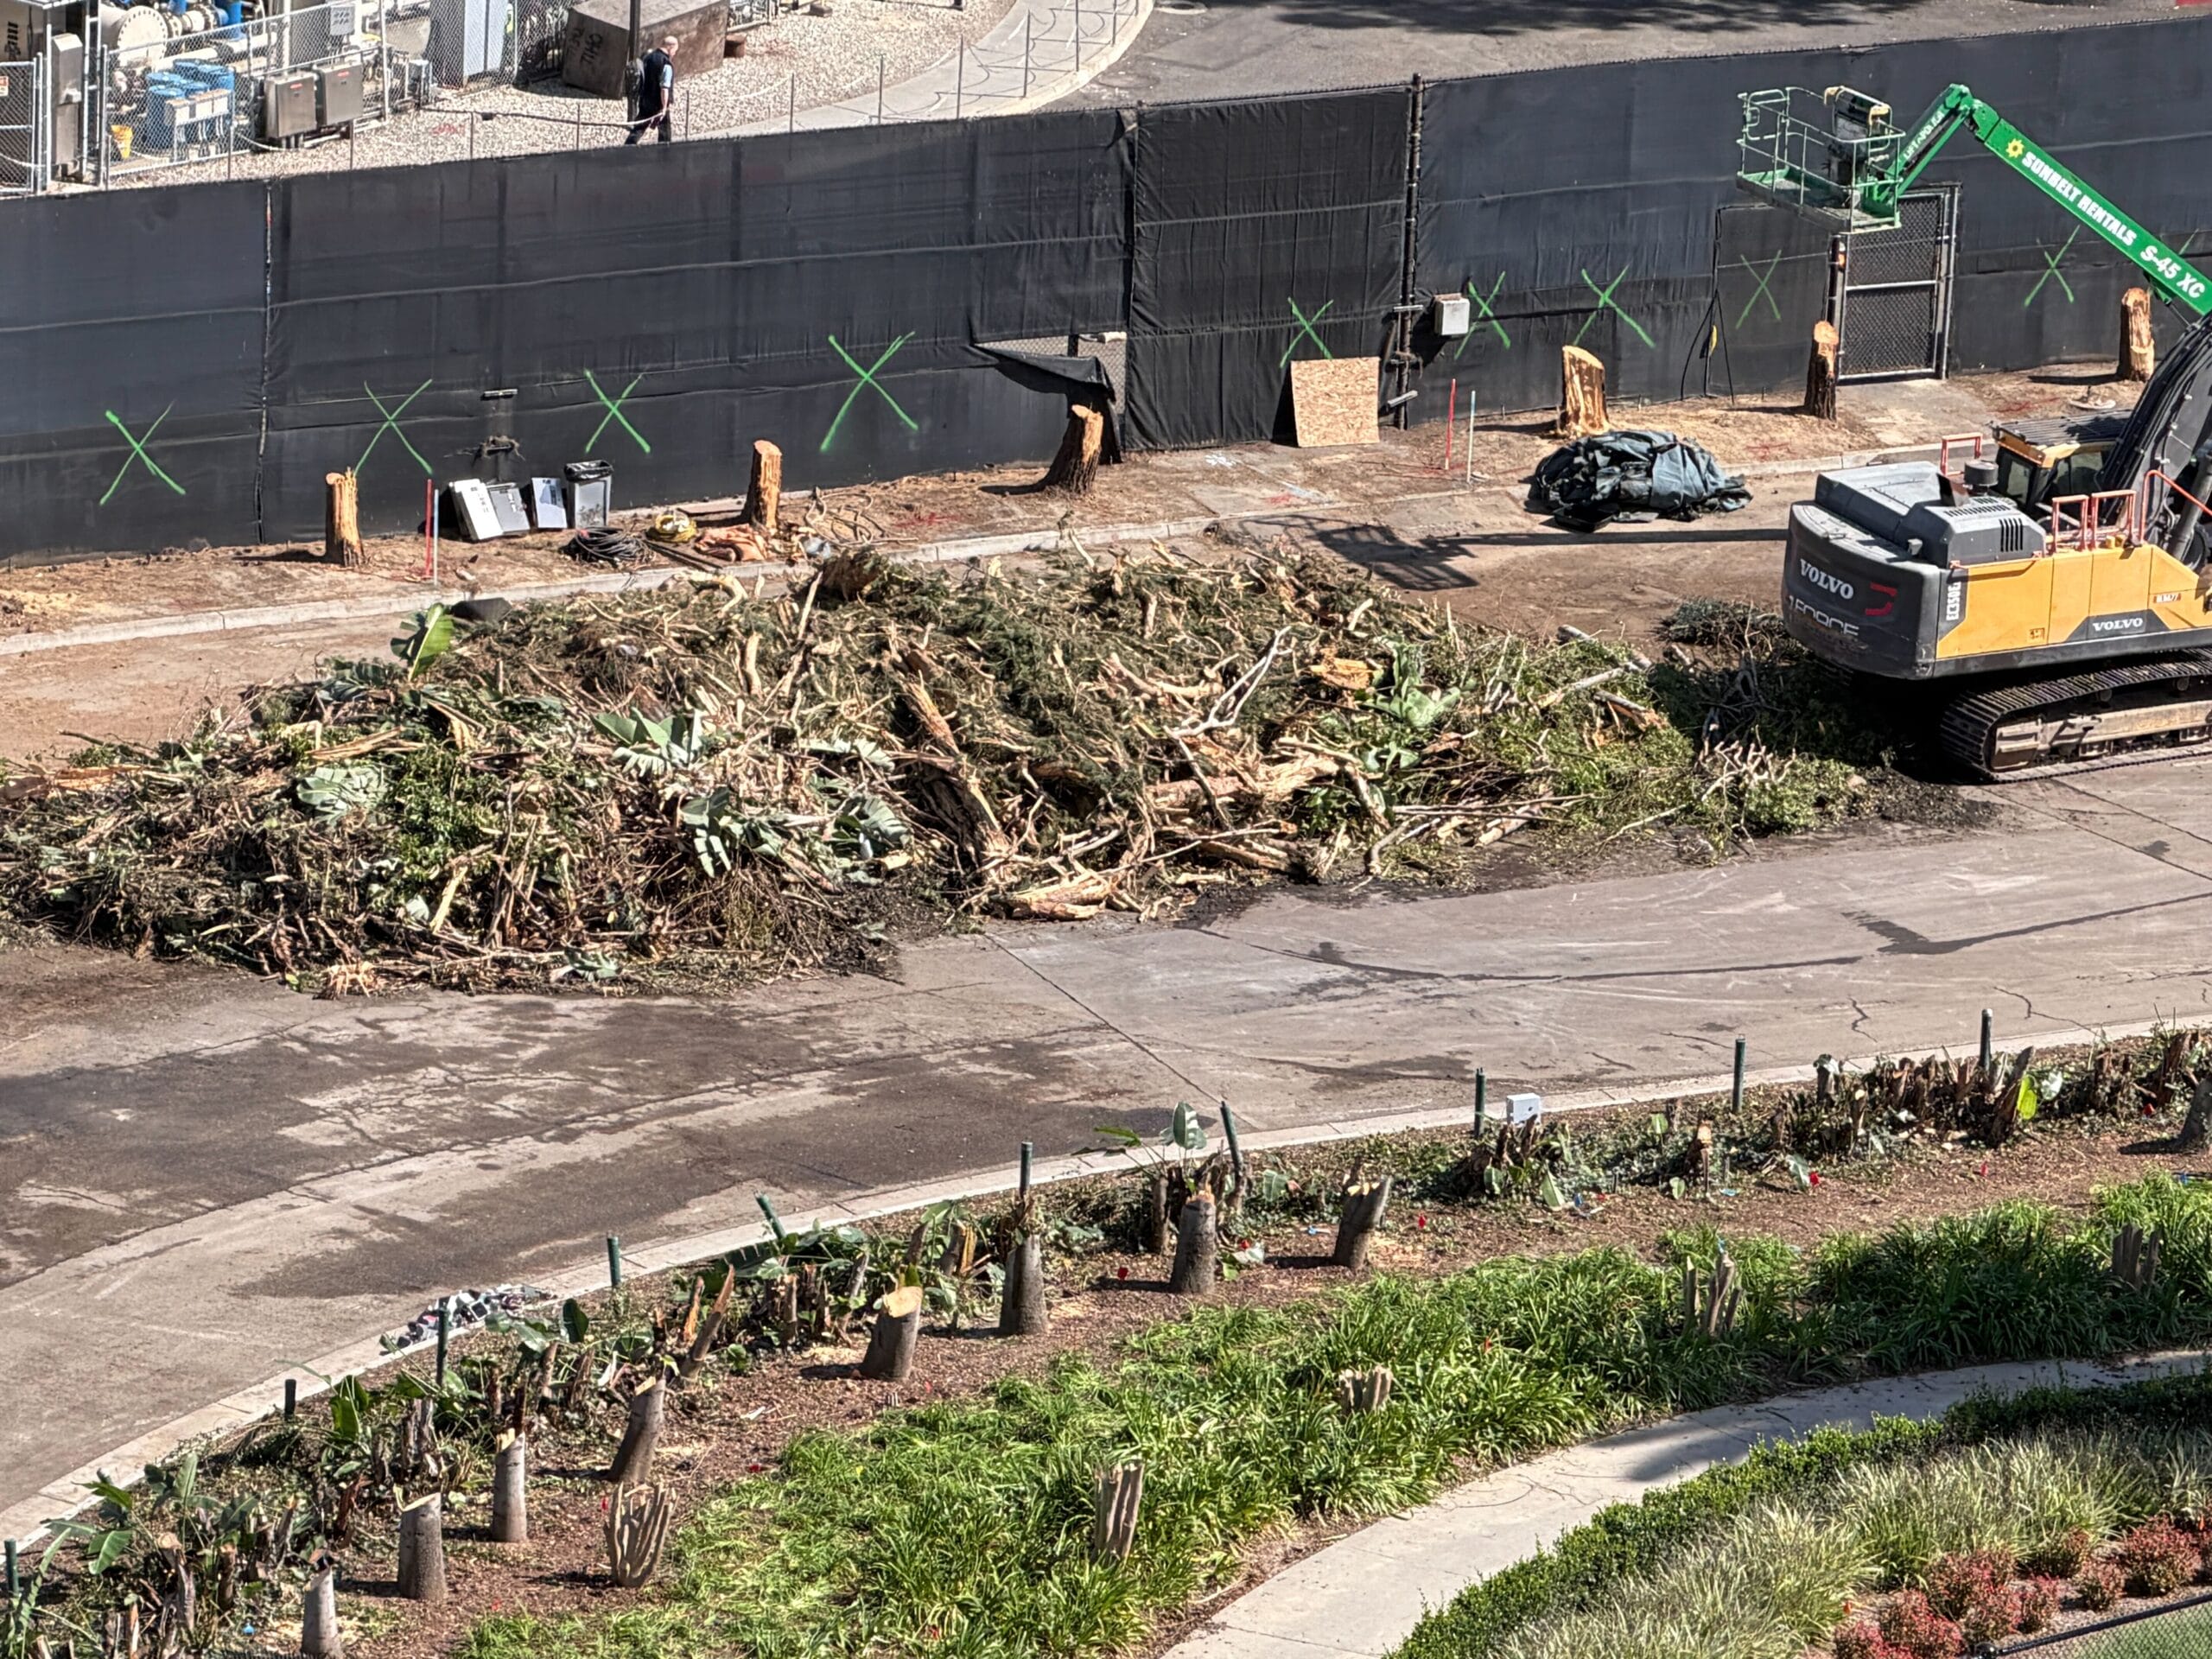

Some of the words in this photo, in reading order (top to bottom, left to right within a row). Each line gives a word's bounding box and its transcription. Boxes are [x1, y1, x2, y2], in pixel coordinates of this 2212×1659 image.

[2022, 151, 2082, 202] SUNBELT
[2077, 194, 2137, 245] RENTALS
[2140, 245, 2182, 278] S-45
[2177, 272, 2205, 298] XC
[1800, 558, 1854, 600] VOLVO
[2093, 617, 2143, 632] VOLVO
